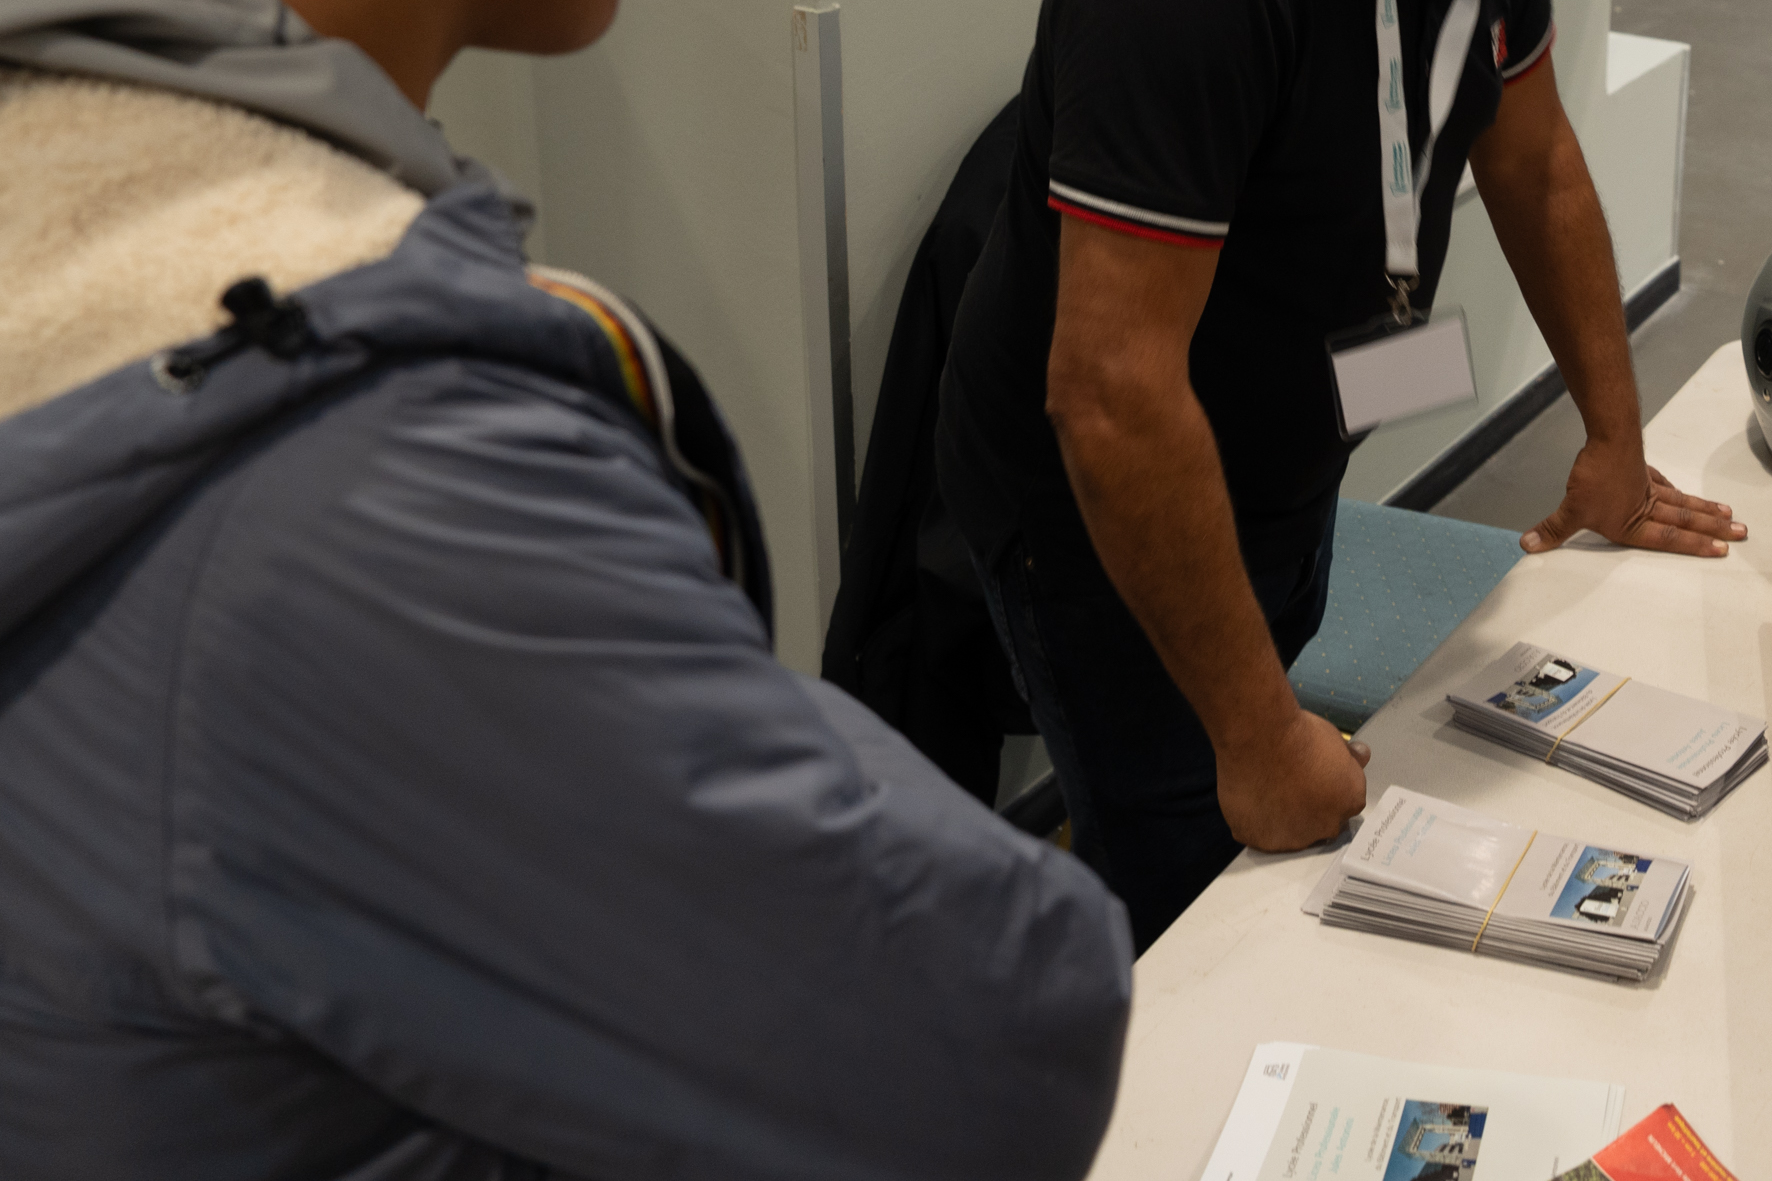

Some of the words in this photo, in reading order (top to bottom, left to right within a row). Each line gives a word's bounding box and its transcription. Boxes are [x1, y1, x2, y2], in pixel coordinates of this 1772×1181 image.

[1360, 837, 1380, 861] Lycée
[1374, 797, 1407, 838] Professionnel
[1291, 1101, 1318, 1154] Professionnel
[1647, 1133, 1672, 1164] MICHELIN
